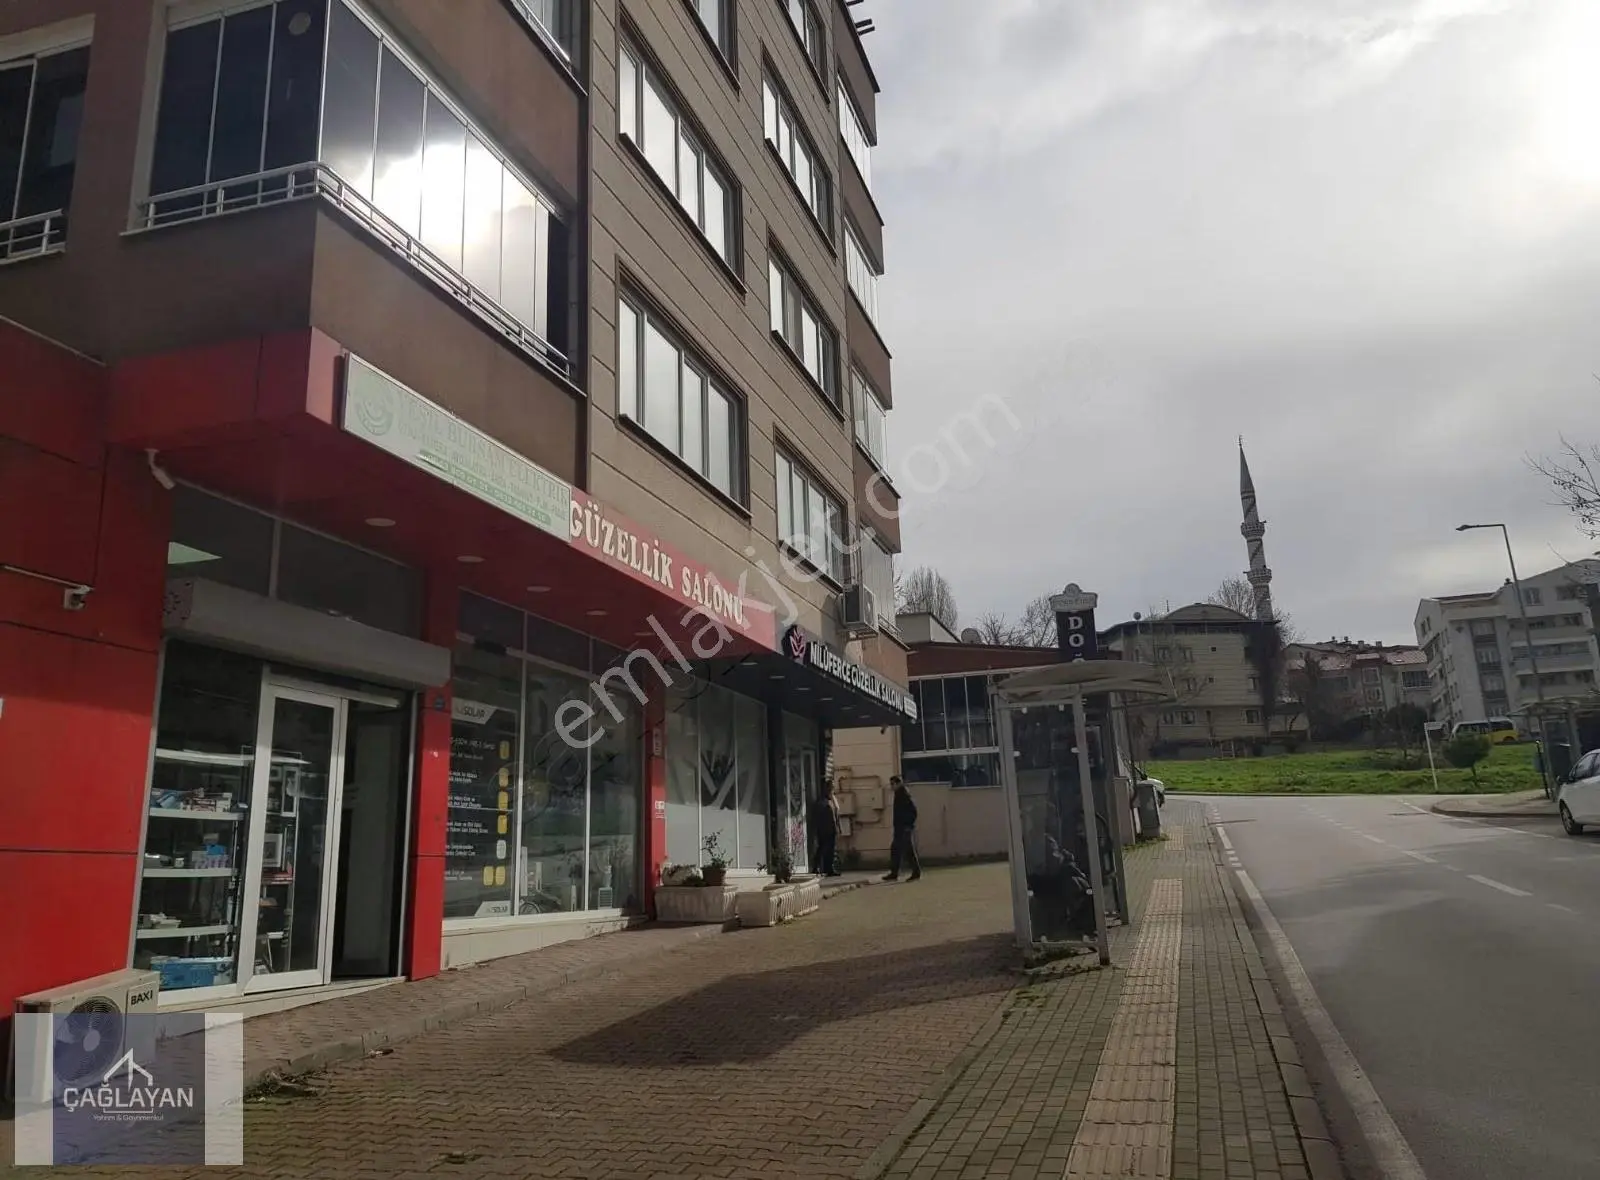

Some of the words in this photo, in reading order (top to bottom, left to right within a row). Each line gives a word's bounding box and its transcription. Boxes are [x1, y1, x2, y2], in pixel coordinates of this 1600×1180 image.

[570, 500, 674, 589] GÜZELLİK
[681, 566, 744, 625] SALONU
[130, 990, 153, 1005] BAXI
